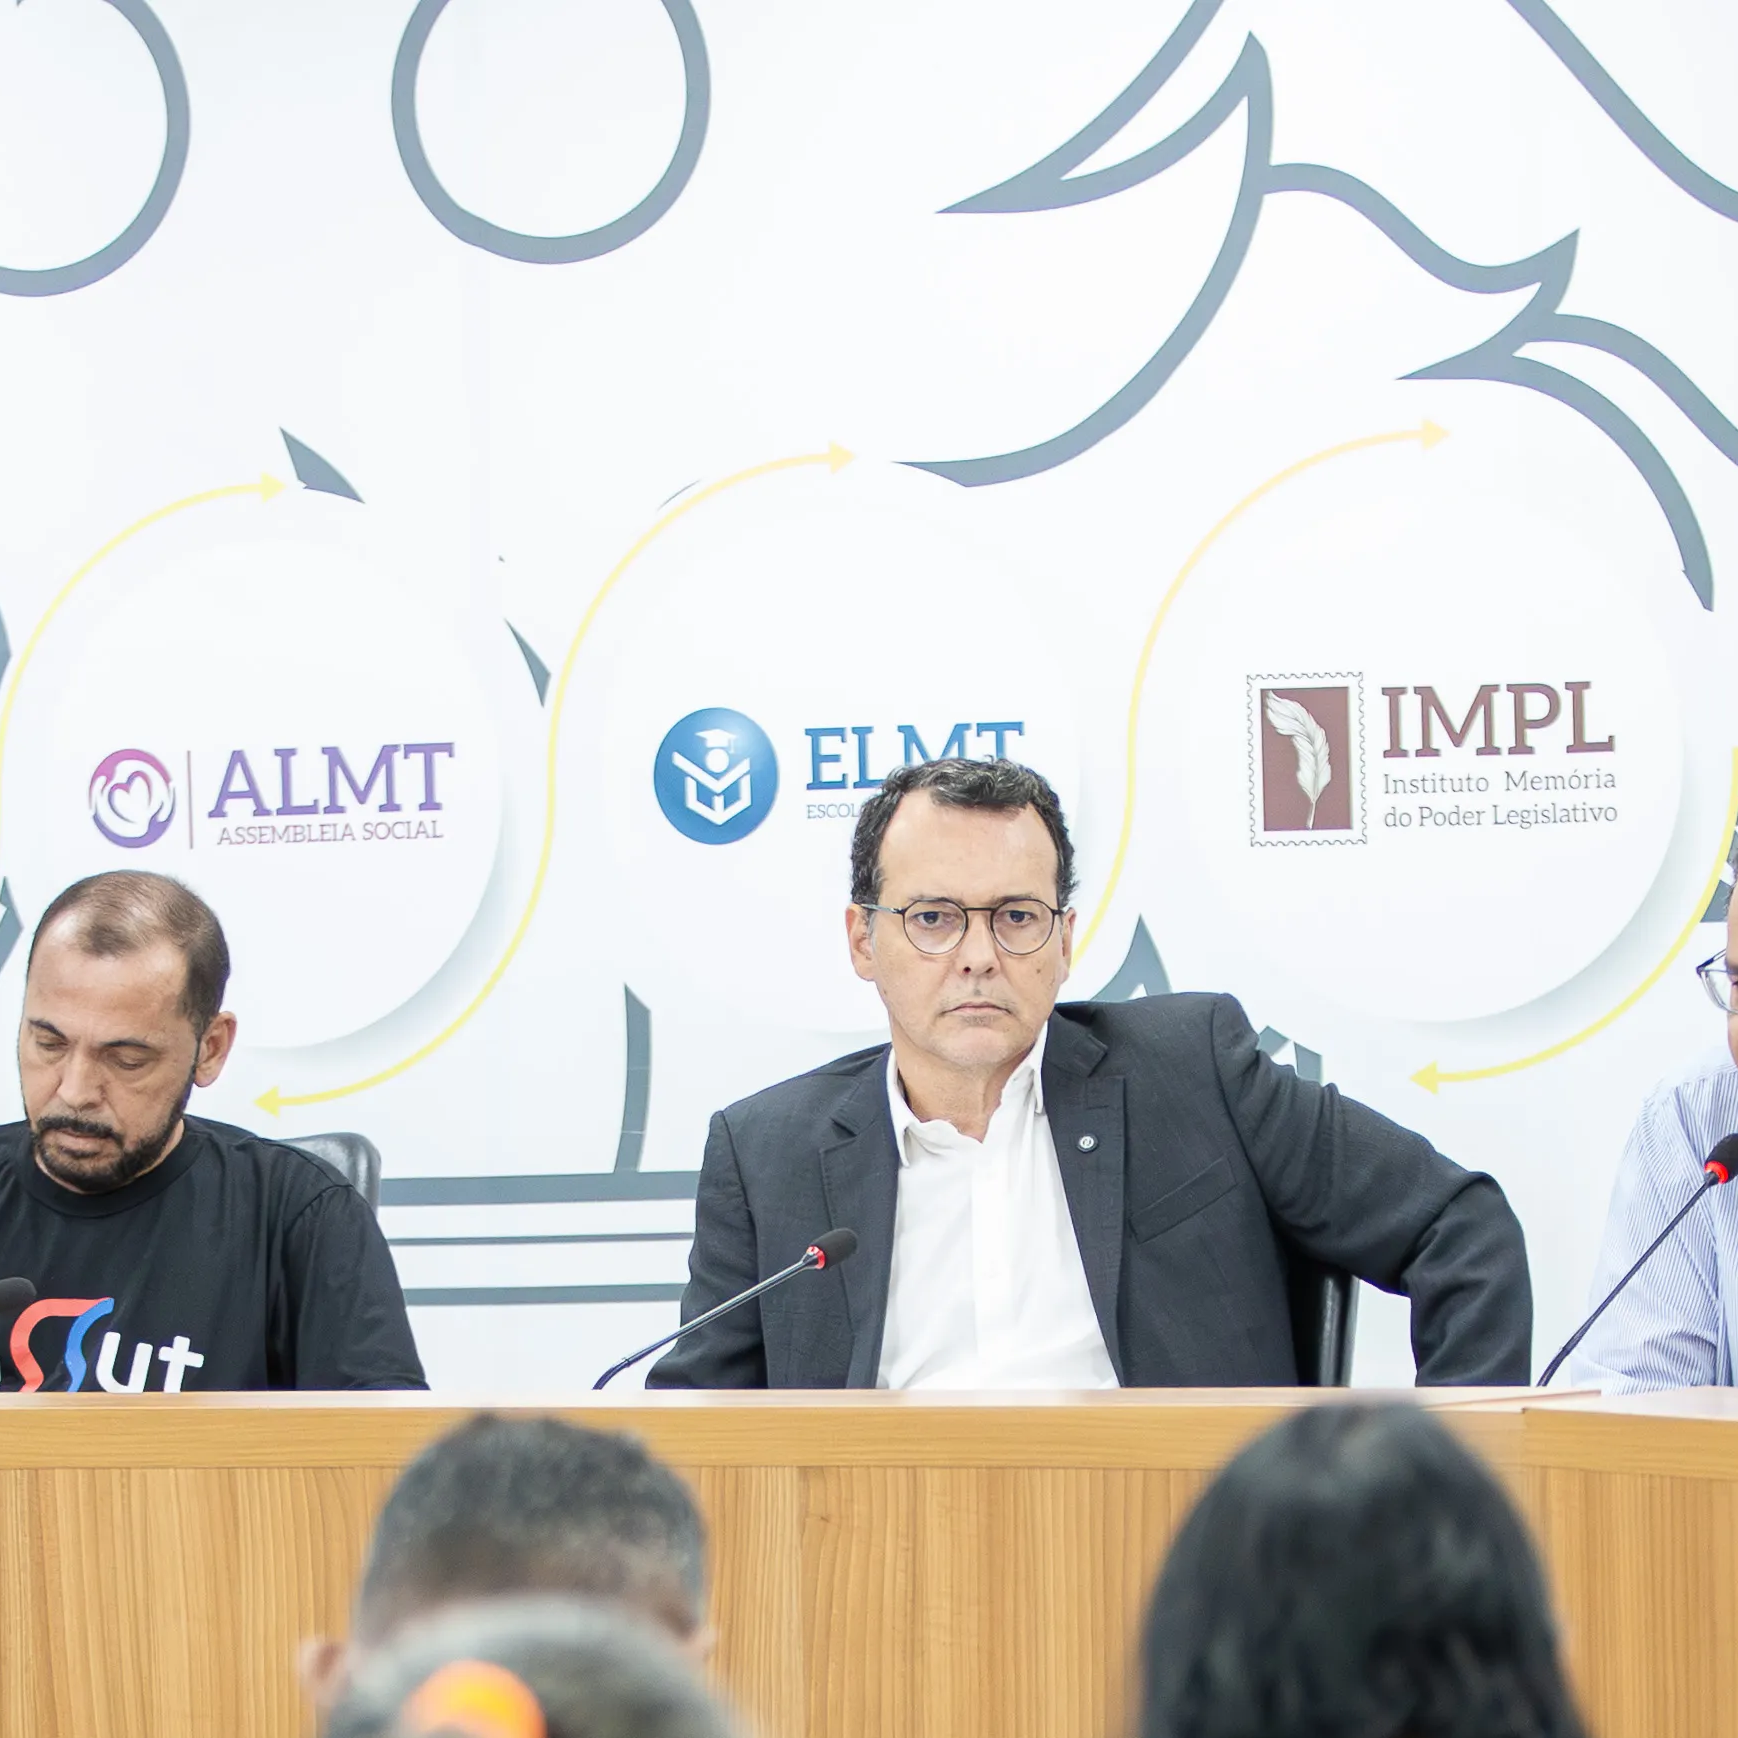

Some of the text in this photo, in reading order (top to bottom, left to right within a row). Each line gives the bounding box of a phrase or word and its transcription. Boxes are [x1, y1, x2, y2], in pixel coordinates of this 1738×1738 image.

[1381, 681, 1616, 758] IMPL
[207, 742, 455, 818] ALMT
[1384, 768, 1617, 795] Instituto Memória
[807, 803, 861, 819] ESCOL
[1384, 801, 1618, 829] do Poder Legislativo
[217, 820, 444, 846] ASSEMBLEIA SOCIAL
